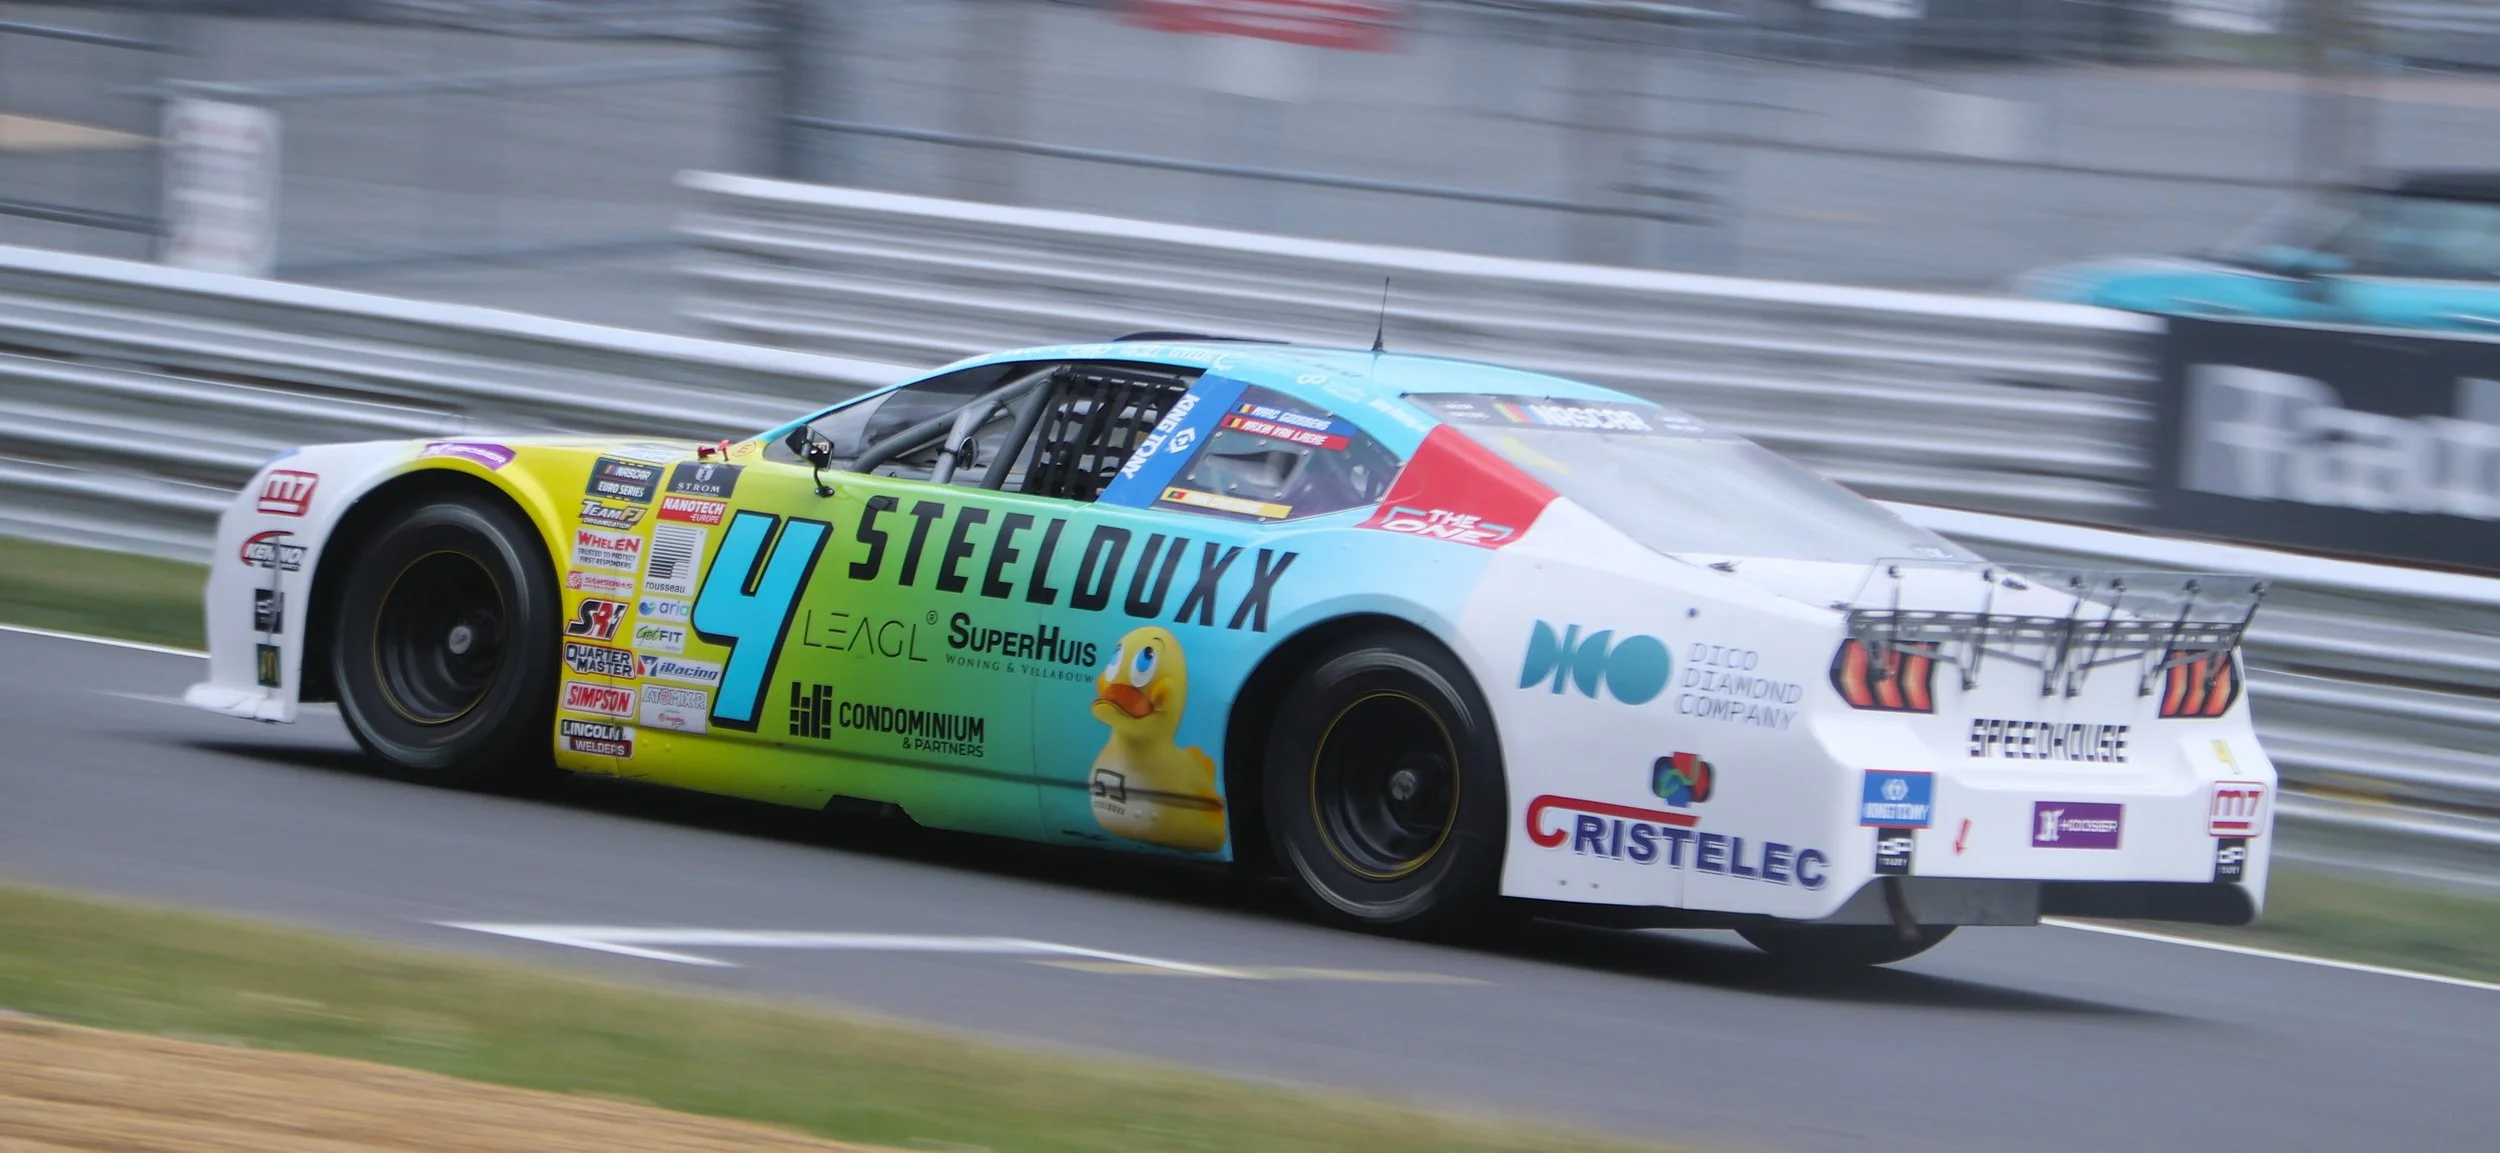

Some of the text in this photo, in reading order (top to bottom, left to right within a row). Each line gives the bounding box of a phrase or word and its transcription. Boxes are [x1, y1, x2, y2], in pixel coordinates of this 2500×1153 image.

[1155, 393, 1200, 433] KING
[1120, 433, 1168, 479] TONY
[615, 466, 652, 481] NASCAR
[597, 481, 646, 498] EURO SERIES
[677, 482, 720, 493] STROM
[663, 497, 725, 514] NANOTECH
[1428, 508, 1482, 529] THE
[1382, 519, 1498, 543] ONE
[578, 547, 637, 561] TRUSTED TO PROTECT
[579, 556, 632, 569] FIRST RESPONDERS
[848, 495, 1299, 633] STEELDUXX
[645, 581, 686, 594] rousseau
[659, 601, 689, 614] aria
[691, 509, 833, 732] 4
[566, 644, 630, 664] QUARTER
[945, 654, 1001, 672] WONING
[1006, 663, 1015, 674] &
[1518, 619, 1673, 706] DICO
[1688, 642, 1760, 672] DICO
[576, 656, 632, 677] MASTER
[659, 661, 719, 681] iRacing
[1680, 667, 1803, 704] DIAMOND
[567, 685, 631, 712] SIMPSON
[838, 701, 985, 743] CONDOMINIUM
[1677, 692, 1799, 731] COMPANY
[563, 721, 621, 740] LINCOLN
[575, 739, 625, 756] WELDERS
[902, 737, 984, 759] & PARTNERS
[1526, 794, 1831, 891] CRISTELEC
